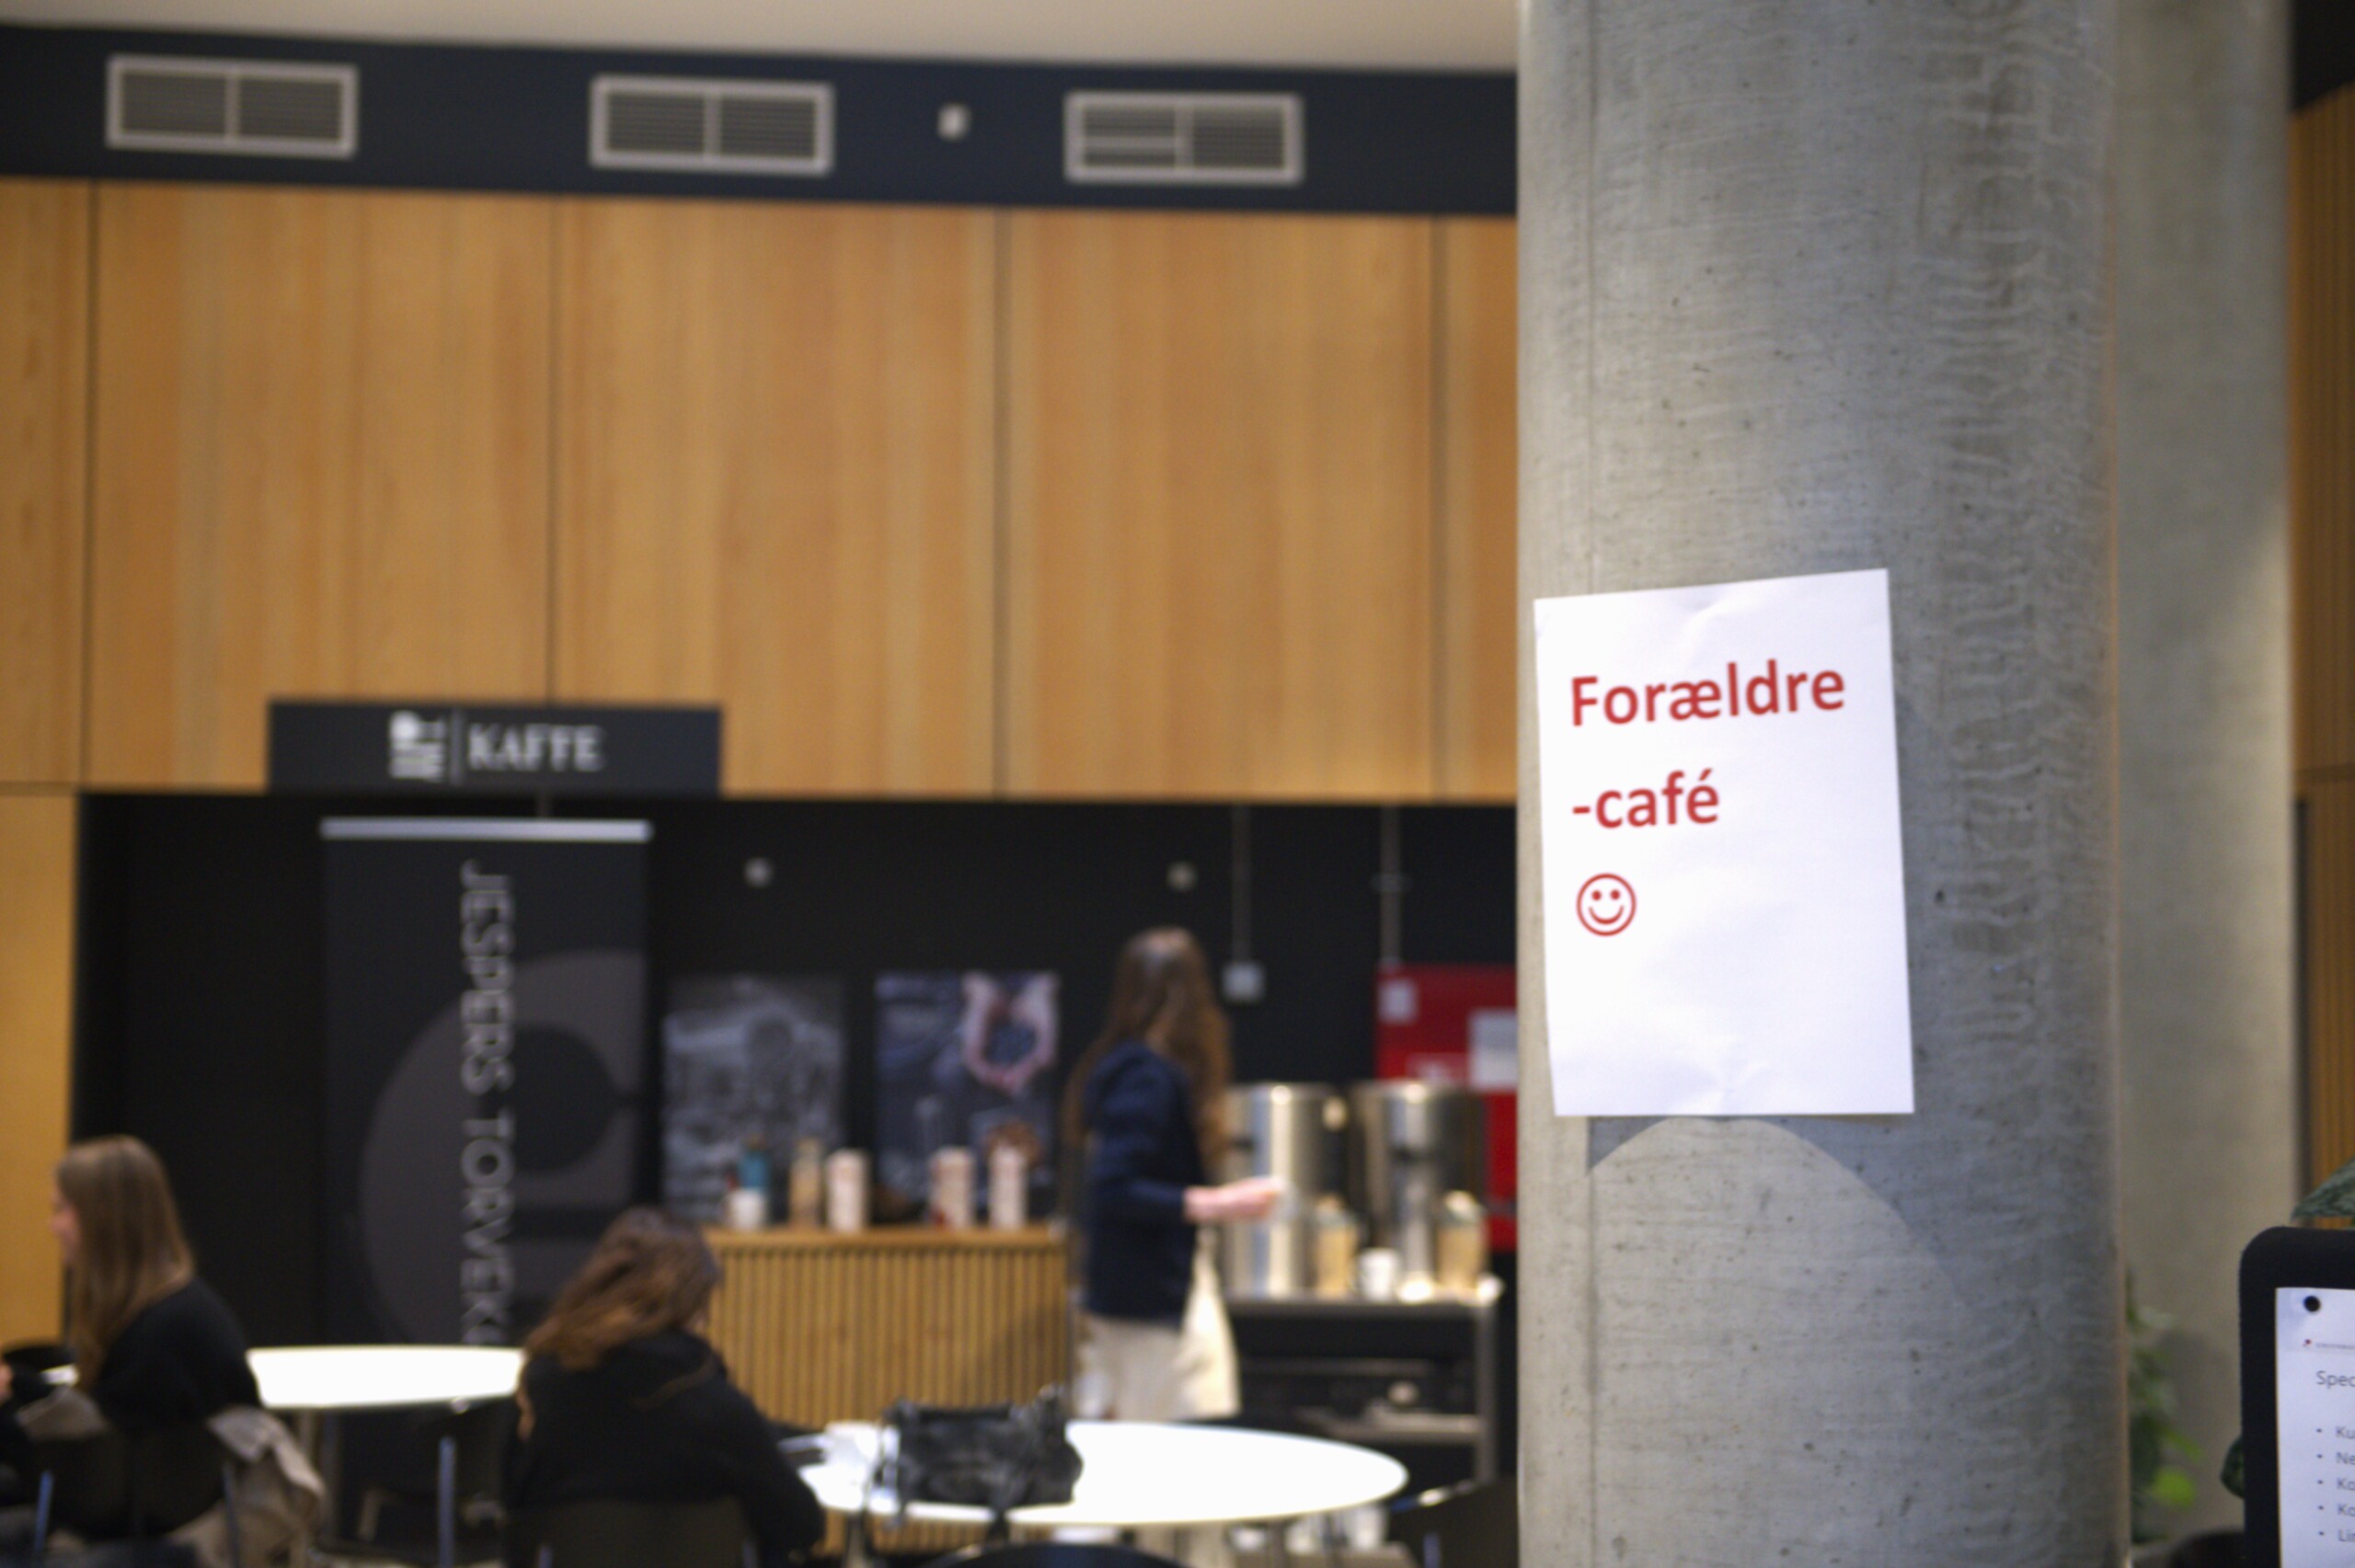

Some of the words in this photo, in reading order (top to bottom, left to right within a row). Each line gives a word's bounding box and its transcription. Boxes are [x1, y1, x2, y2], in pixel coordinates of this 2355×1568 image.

[1571, 658, 1845, 727] Forældre
[467, 723, 603, 773] KAFFE
[1571, 768, 1719, 829] -café
[461, 860, 514, 1094] JESPERS
